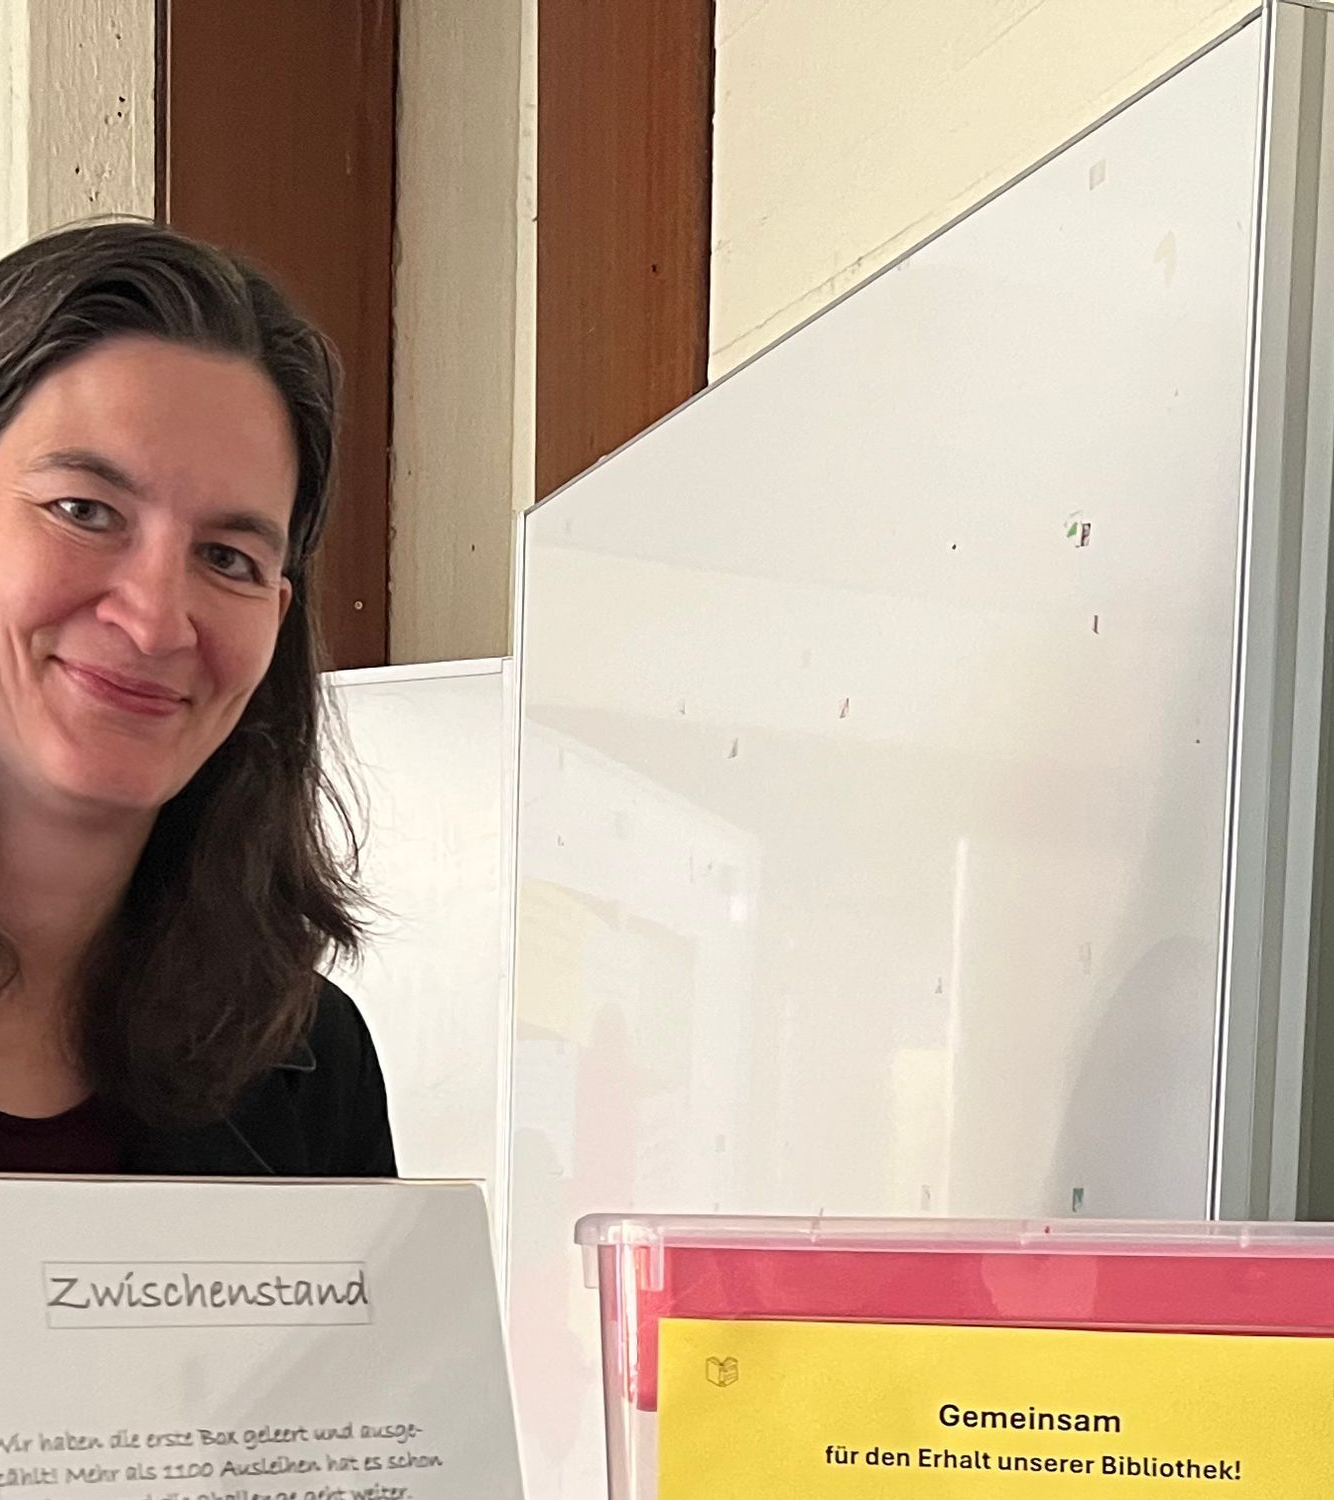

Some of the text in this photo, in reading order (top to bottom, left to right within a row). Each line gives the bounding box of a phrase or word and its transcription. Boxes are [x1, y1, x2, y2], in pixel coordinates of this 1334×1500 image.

[49, 1270, 368, 1310] Zwischenstand
[939, 1403, 1121, 1433] Gemeinsam
[38, 1431, 104, 1452] haben
[110, 1429, 141, 1450] die
[146, 1431, 194, 1449] erste
[196, 1428, 240, 1446] Box
[242, 1425, 310, 1451] geleert
[313, 1422, 355, 1441] und
[360, 1423, 424, 1445] ausge-
[65, 1464, 121, 1484] Mehr
[125, 1462, 158, 1481] als
[219, 1455, 322, 1478] Ausleihen
[325, 1454, 360, 1472] hat
[363, 1456, 383, 1472] es
[386, 1451, 444, 1470] schon
[825, 1445, 1241, 1481] für den Erhalt unserer Bibliothek!
